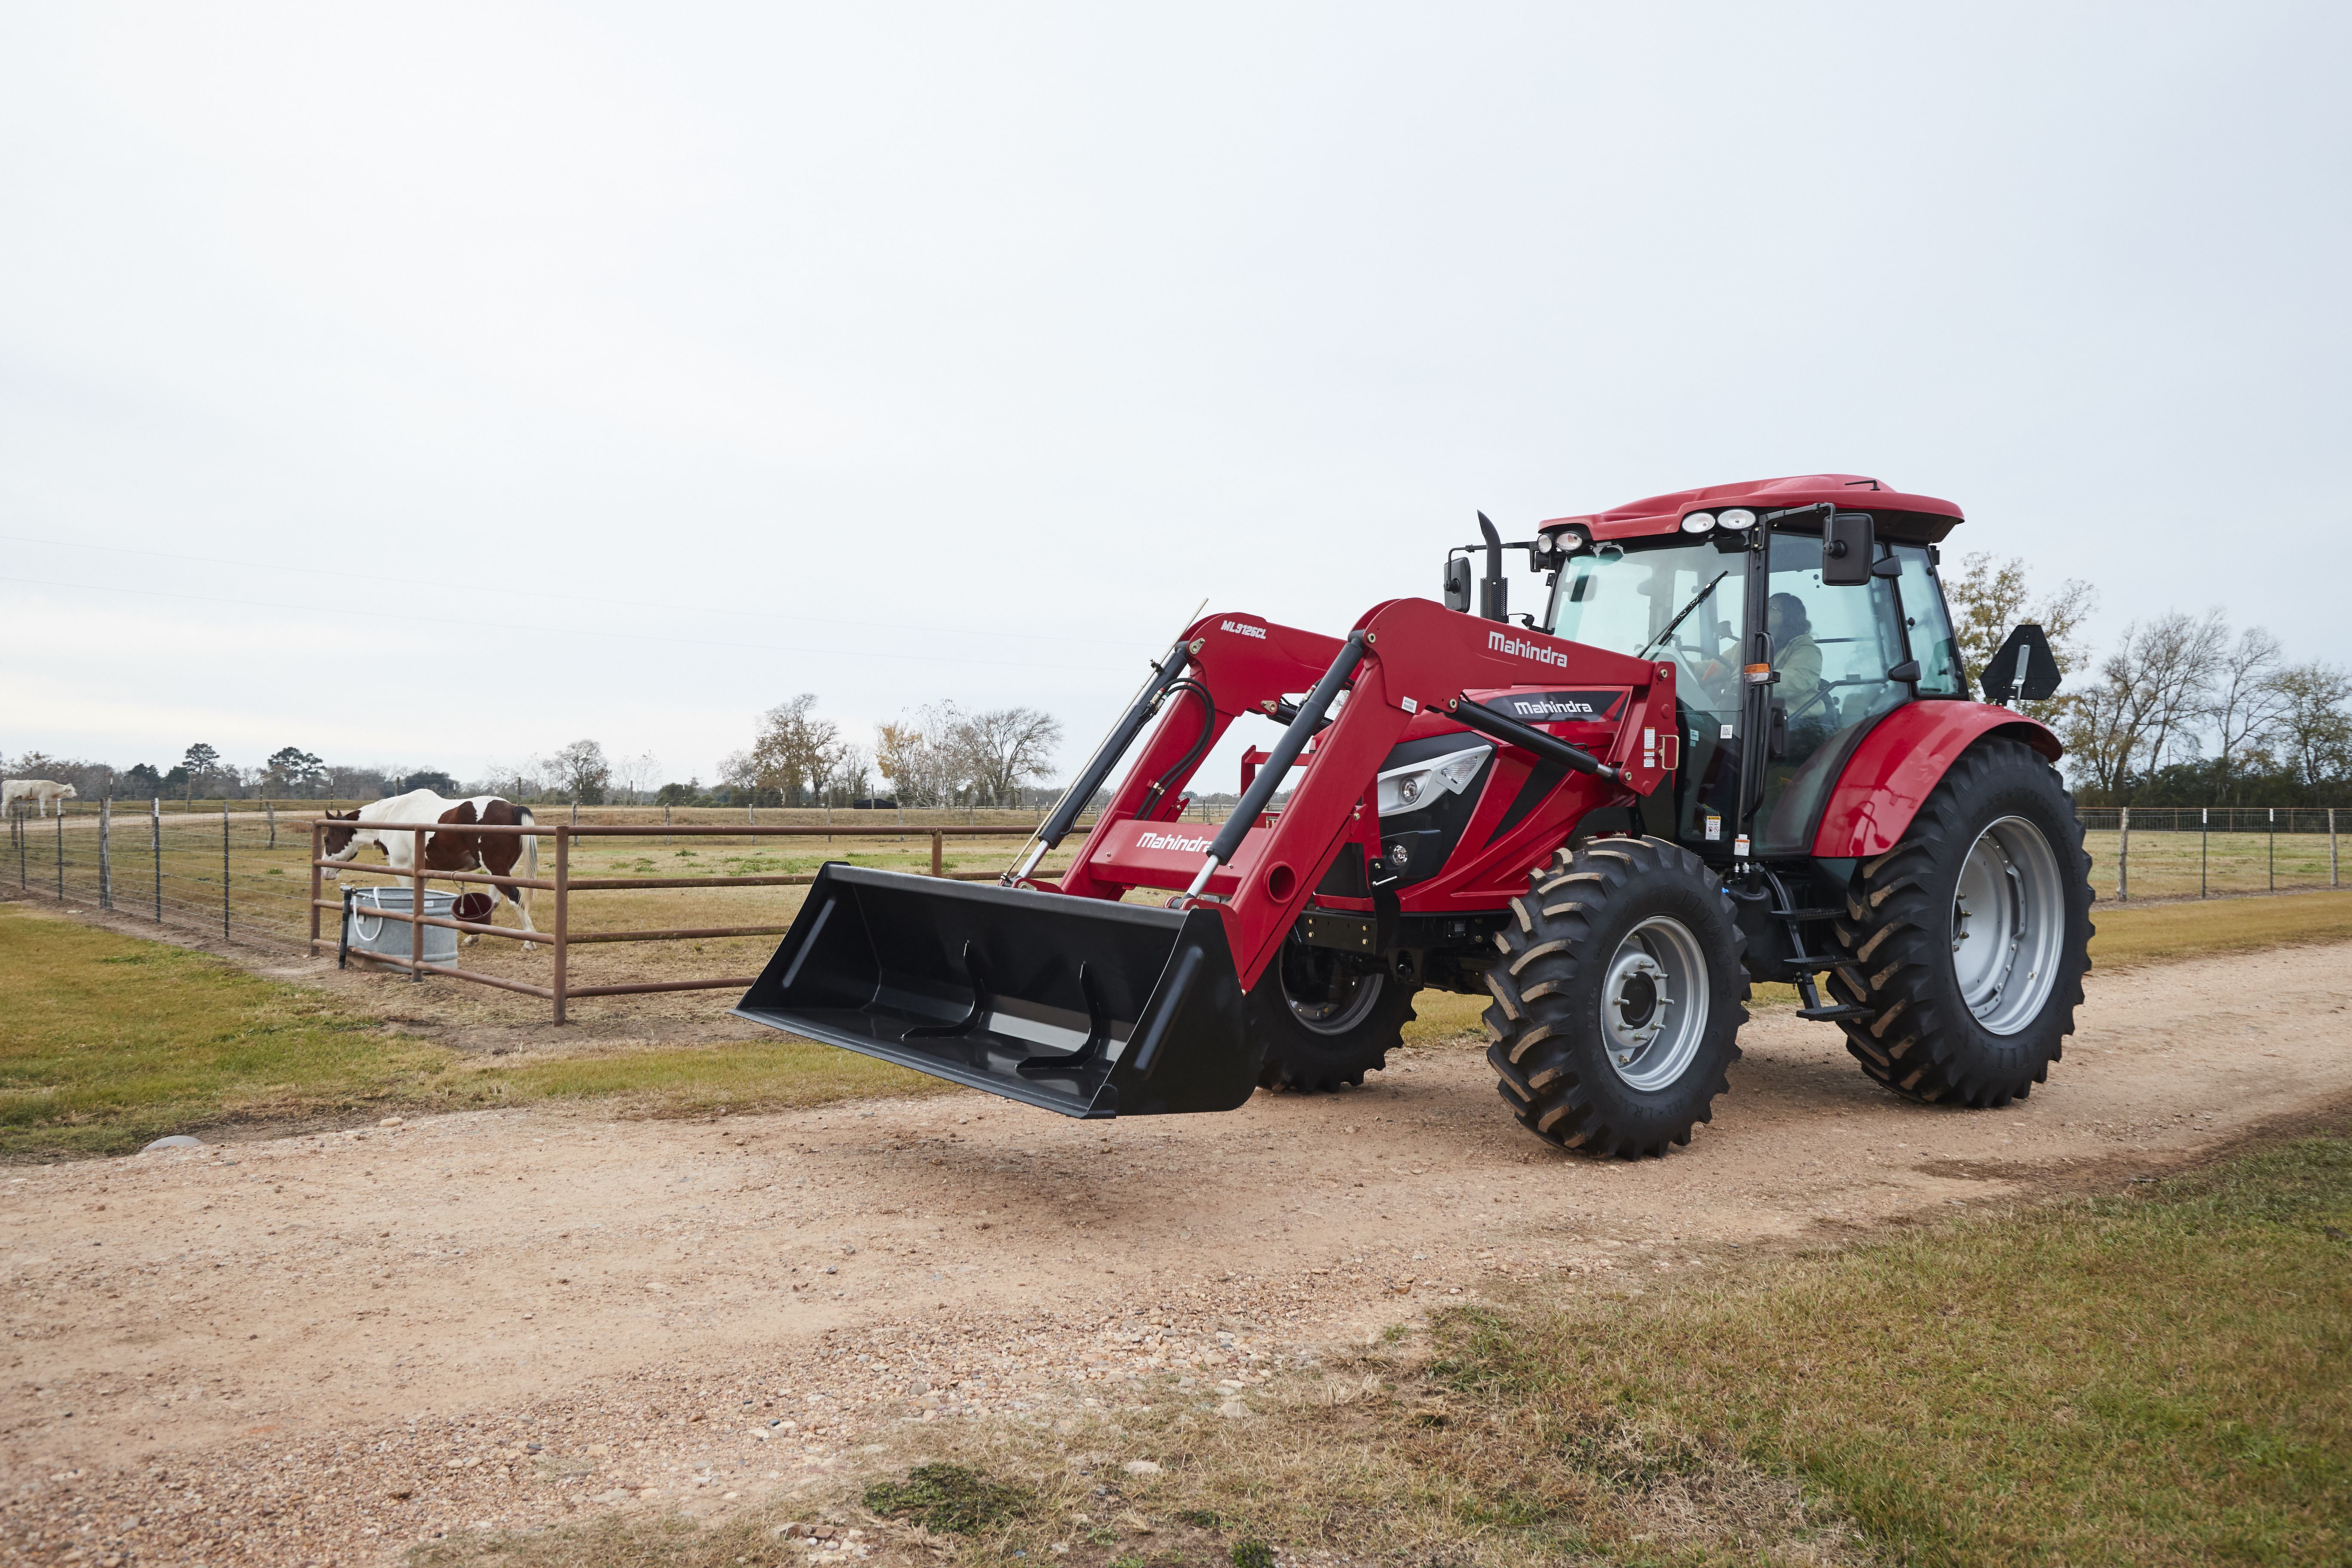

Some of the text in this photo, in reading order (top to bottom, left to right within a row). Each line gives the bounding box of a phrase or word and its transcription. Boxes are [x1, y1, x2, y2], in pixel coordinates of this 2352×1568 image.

[1220, 620, 1266, 640] ML9125CL
[1488, 631, 1568, 668] Mahindra
[1513, 701, 1593, 715] Mahindra
